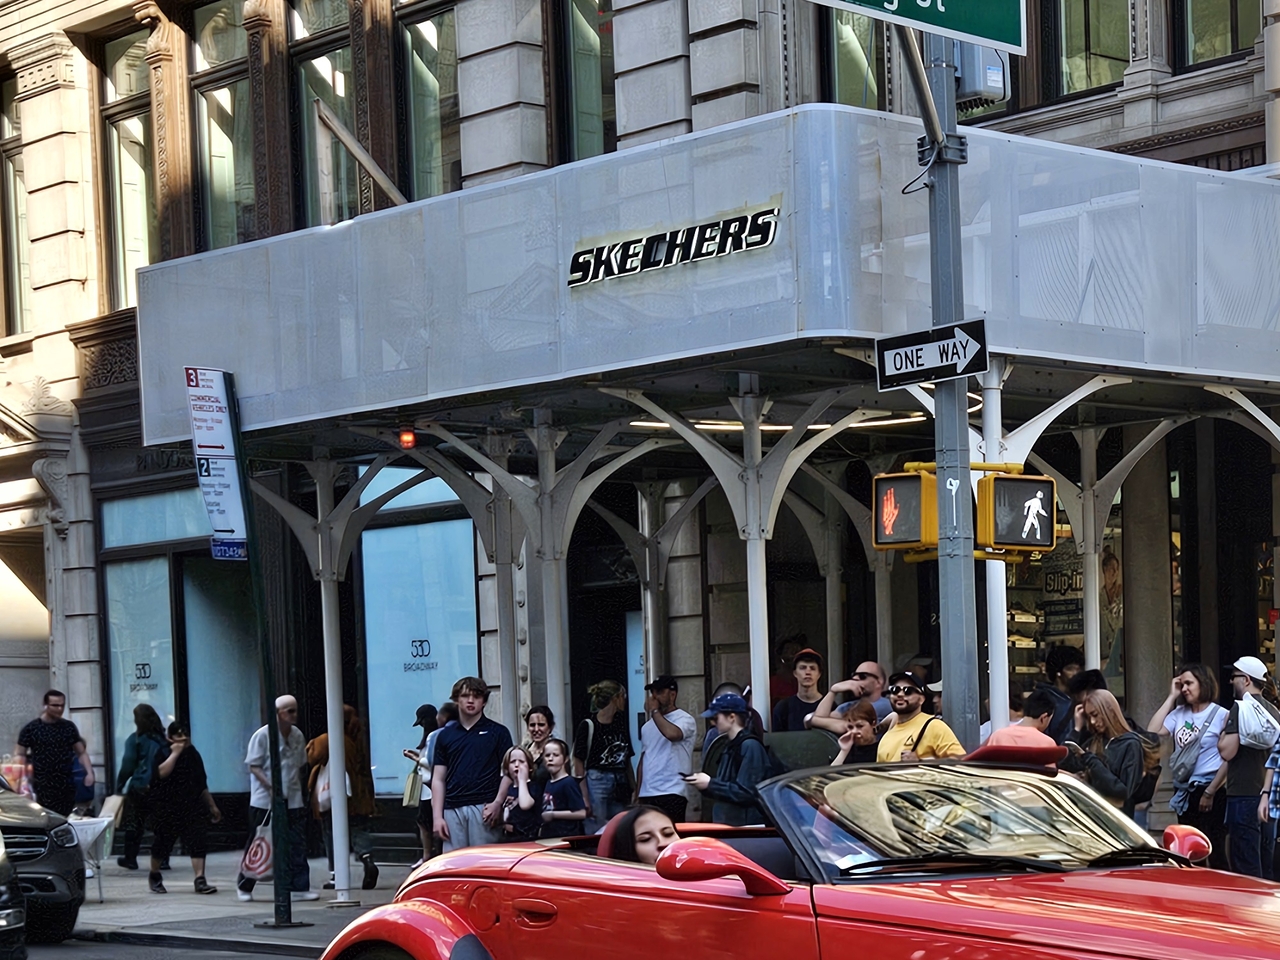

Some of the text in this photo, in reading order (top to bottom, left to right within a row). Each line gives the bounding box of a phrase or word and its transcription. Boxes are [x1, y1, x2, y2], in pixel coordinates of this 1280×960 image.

[568, 208, 781, 288] SKECHERS
[893, 338, 970, 371] ONE WAY
[188, 369, 197, 387] 3
[200, 459, 209, 476] 2
